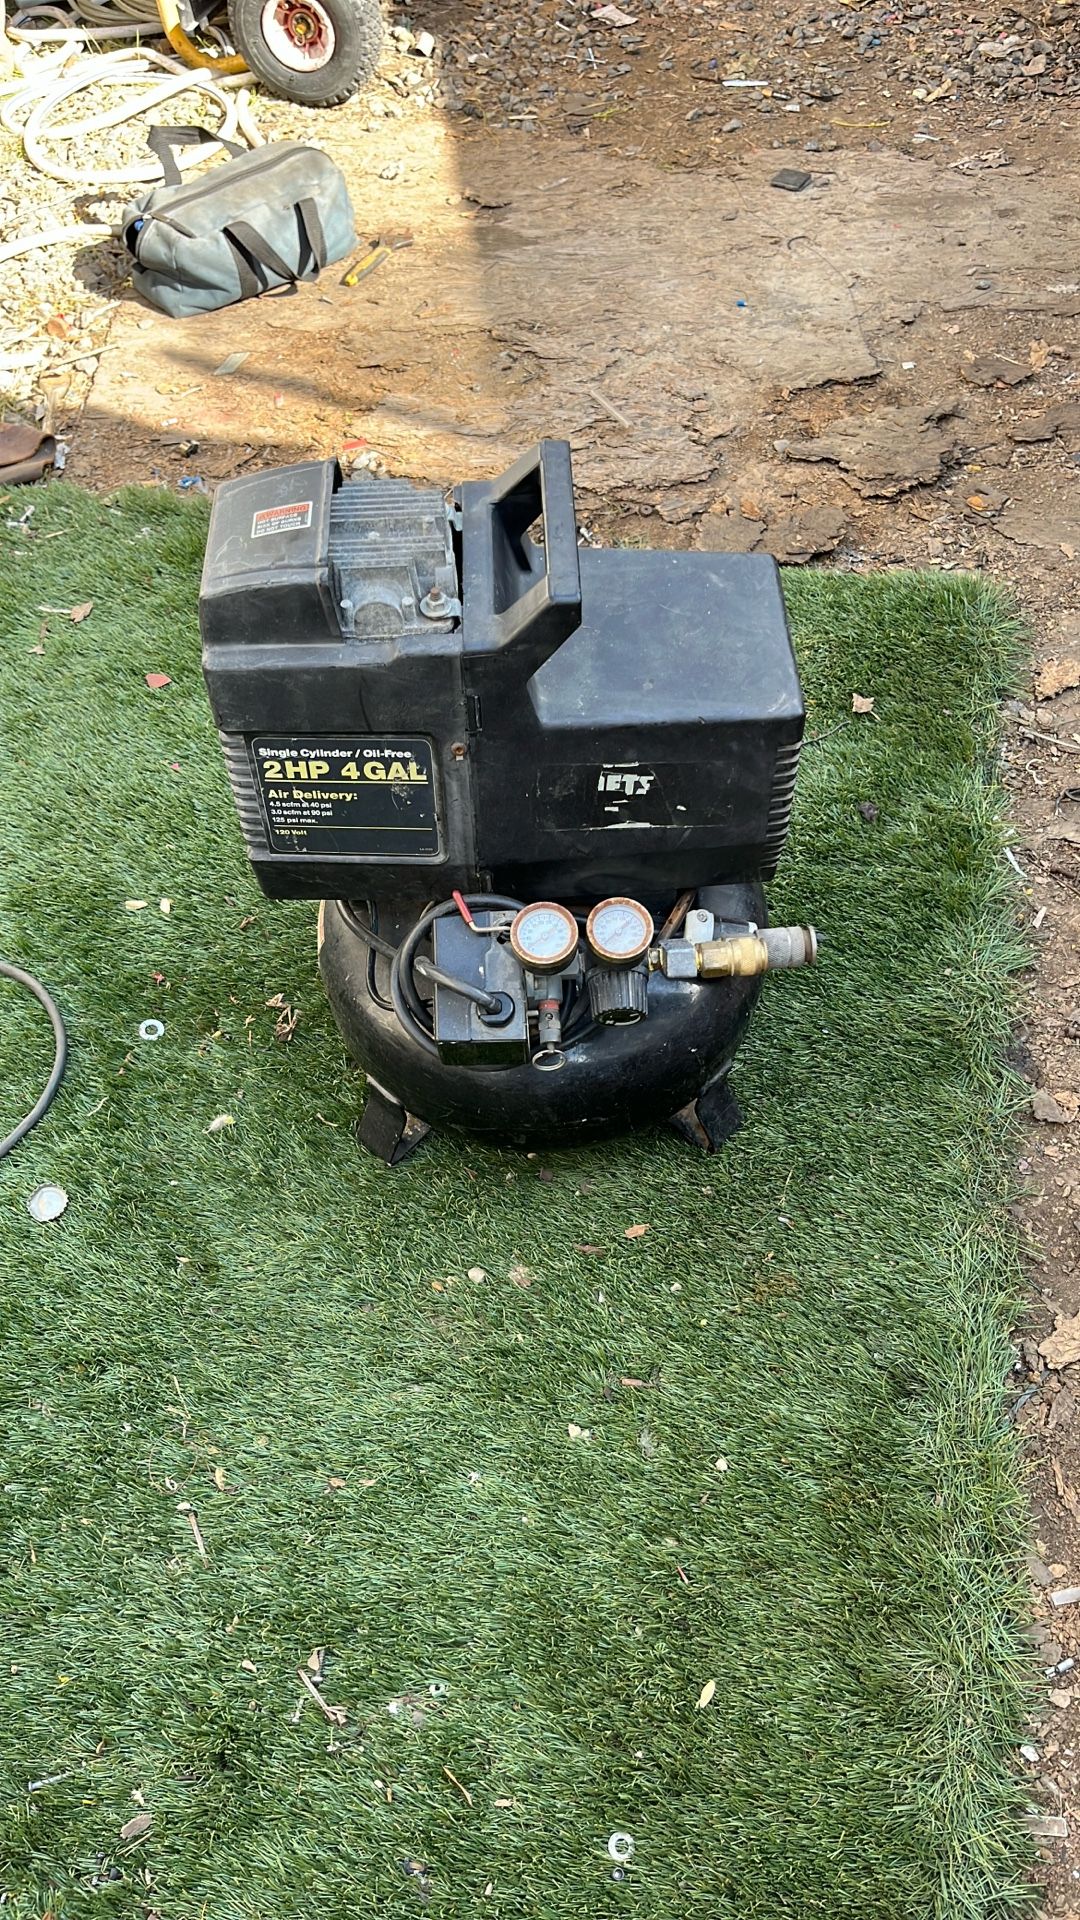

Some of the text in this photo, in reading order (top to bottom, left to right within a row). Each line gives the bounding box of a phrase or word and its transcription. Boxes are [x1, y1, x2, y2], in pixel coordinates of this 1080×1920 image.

[266, 505, 306, 518] WARNING
[258, 747, 412, 759] Single Cylinder / Oil-Free
[263, 760, 330, 779] 2HP
[268, 789, 358, 801] Air Delivery:
